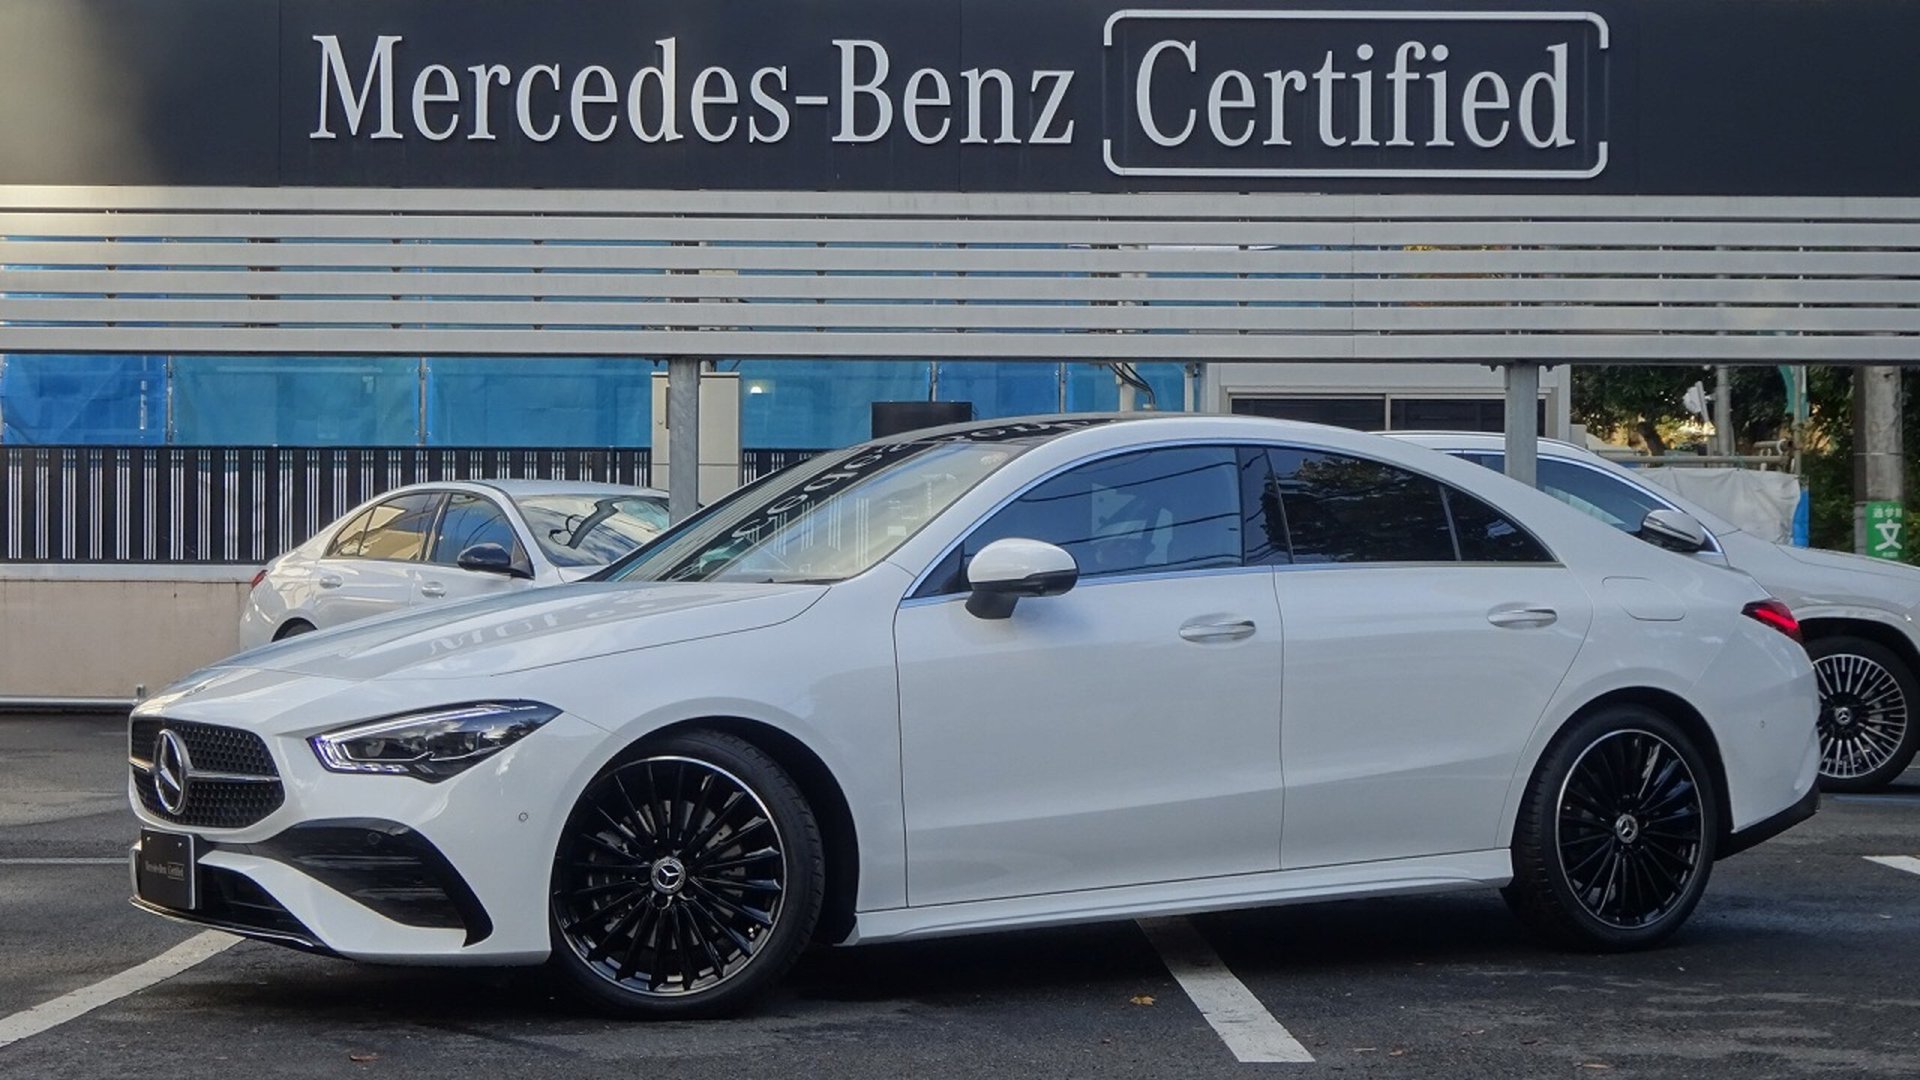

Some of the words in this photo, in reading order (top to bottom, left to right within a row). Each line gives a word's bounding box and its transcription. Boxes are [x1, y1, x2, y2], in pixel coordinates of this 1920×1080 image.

[309, 35, 1075, 145] Mercedes-Benz
[1136, 40, 1576, 148] Certified
[1874, 519, 1903, 551] 文
